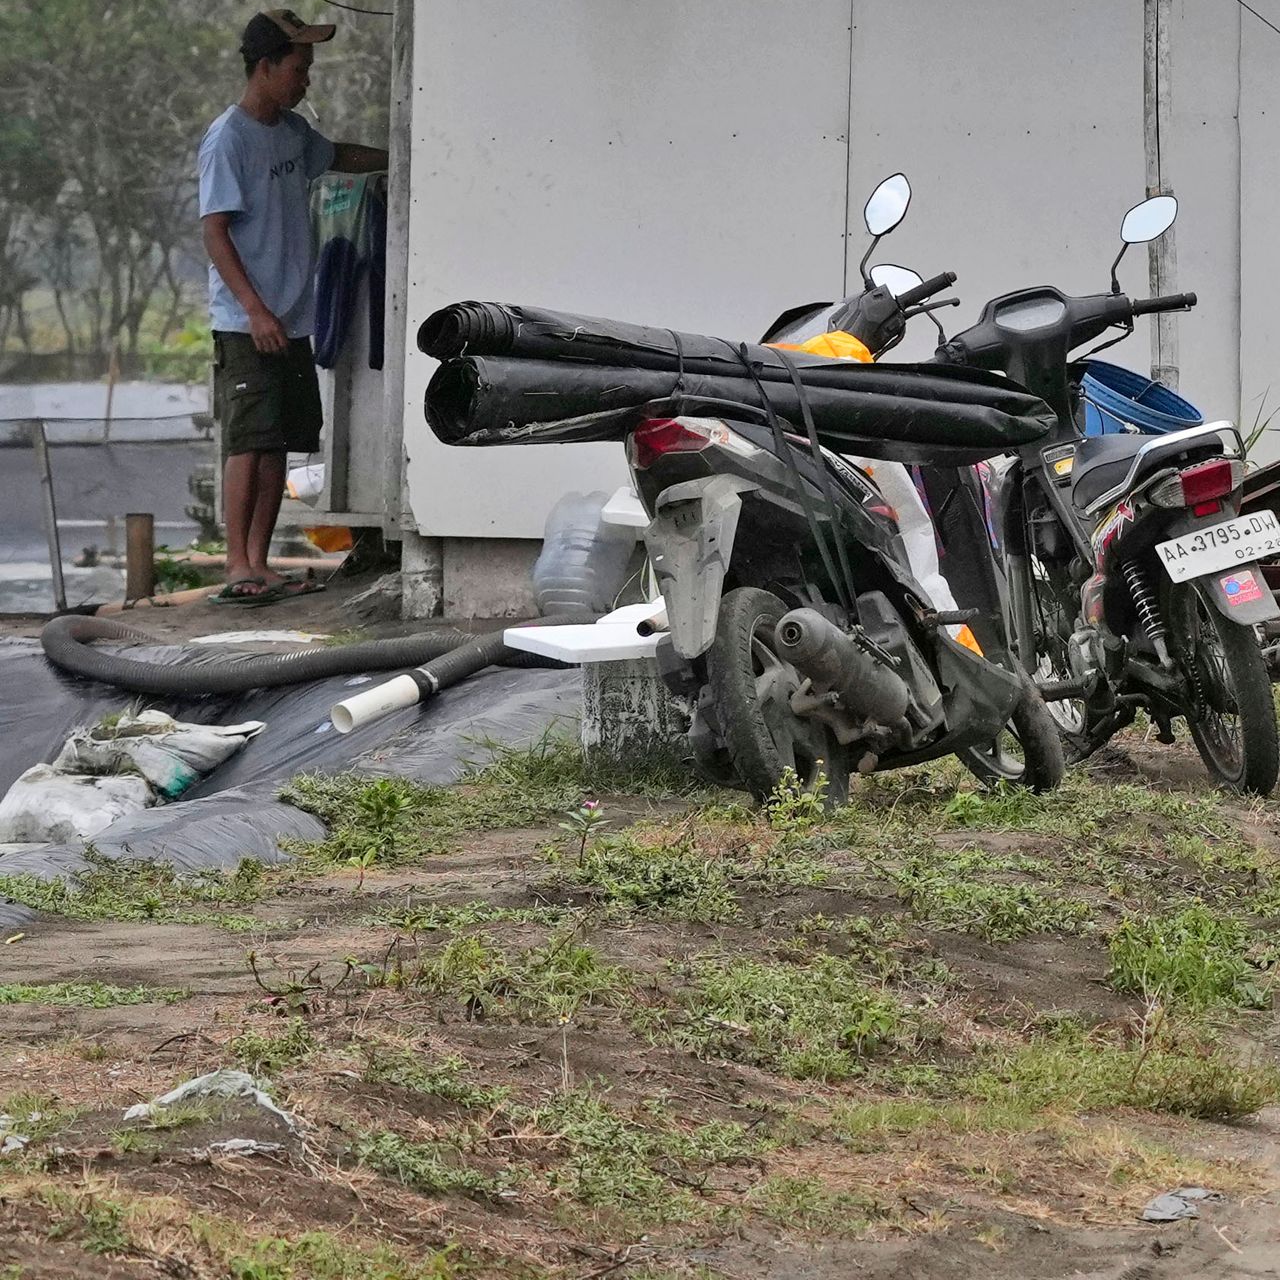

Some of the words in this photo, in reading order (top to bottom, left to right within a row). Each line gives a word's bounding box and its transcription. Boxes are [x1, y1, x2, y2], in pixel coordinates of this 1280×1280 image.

[1163, 542, 1189, 562] AA
[1194, 524, 1241, 552] 3795
[1249, 514, 1277, 534] DW
